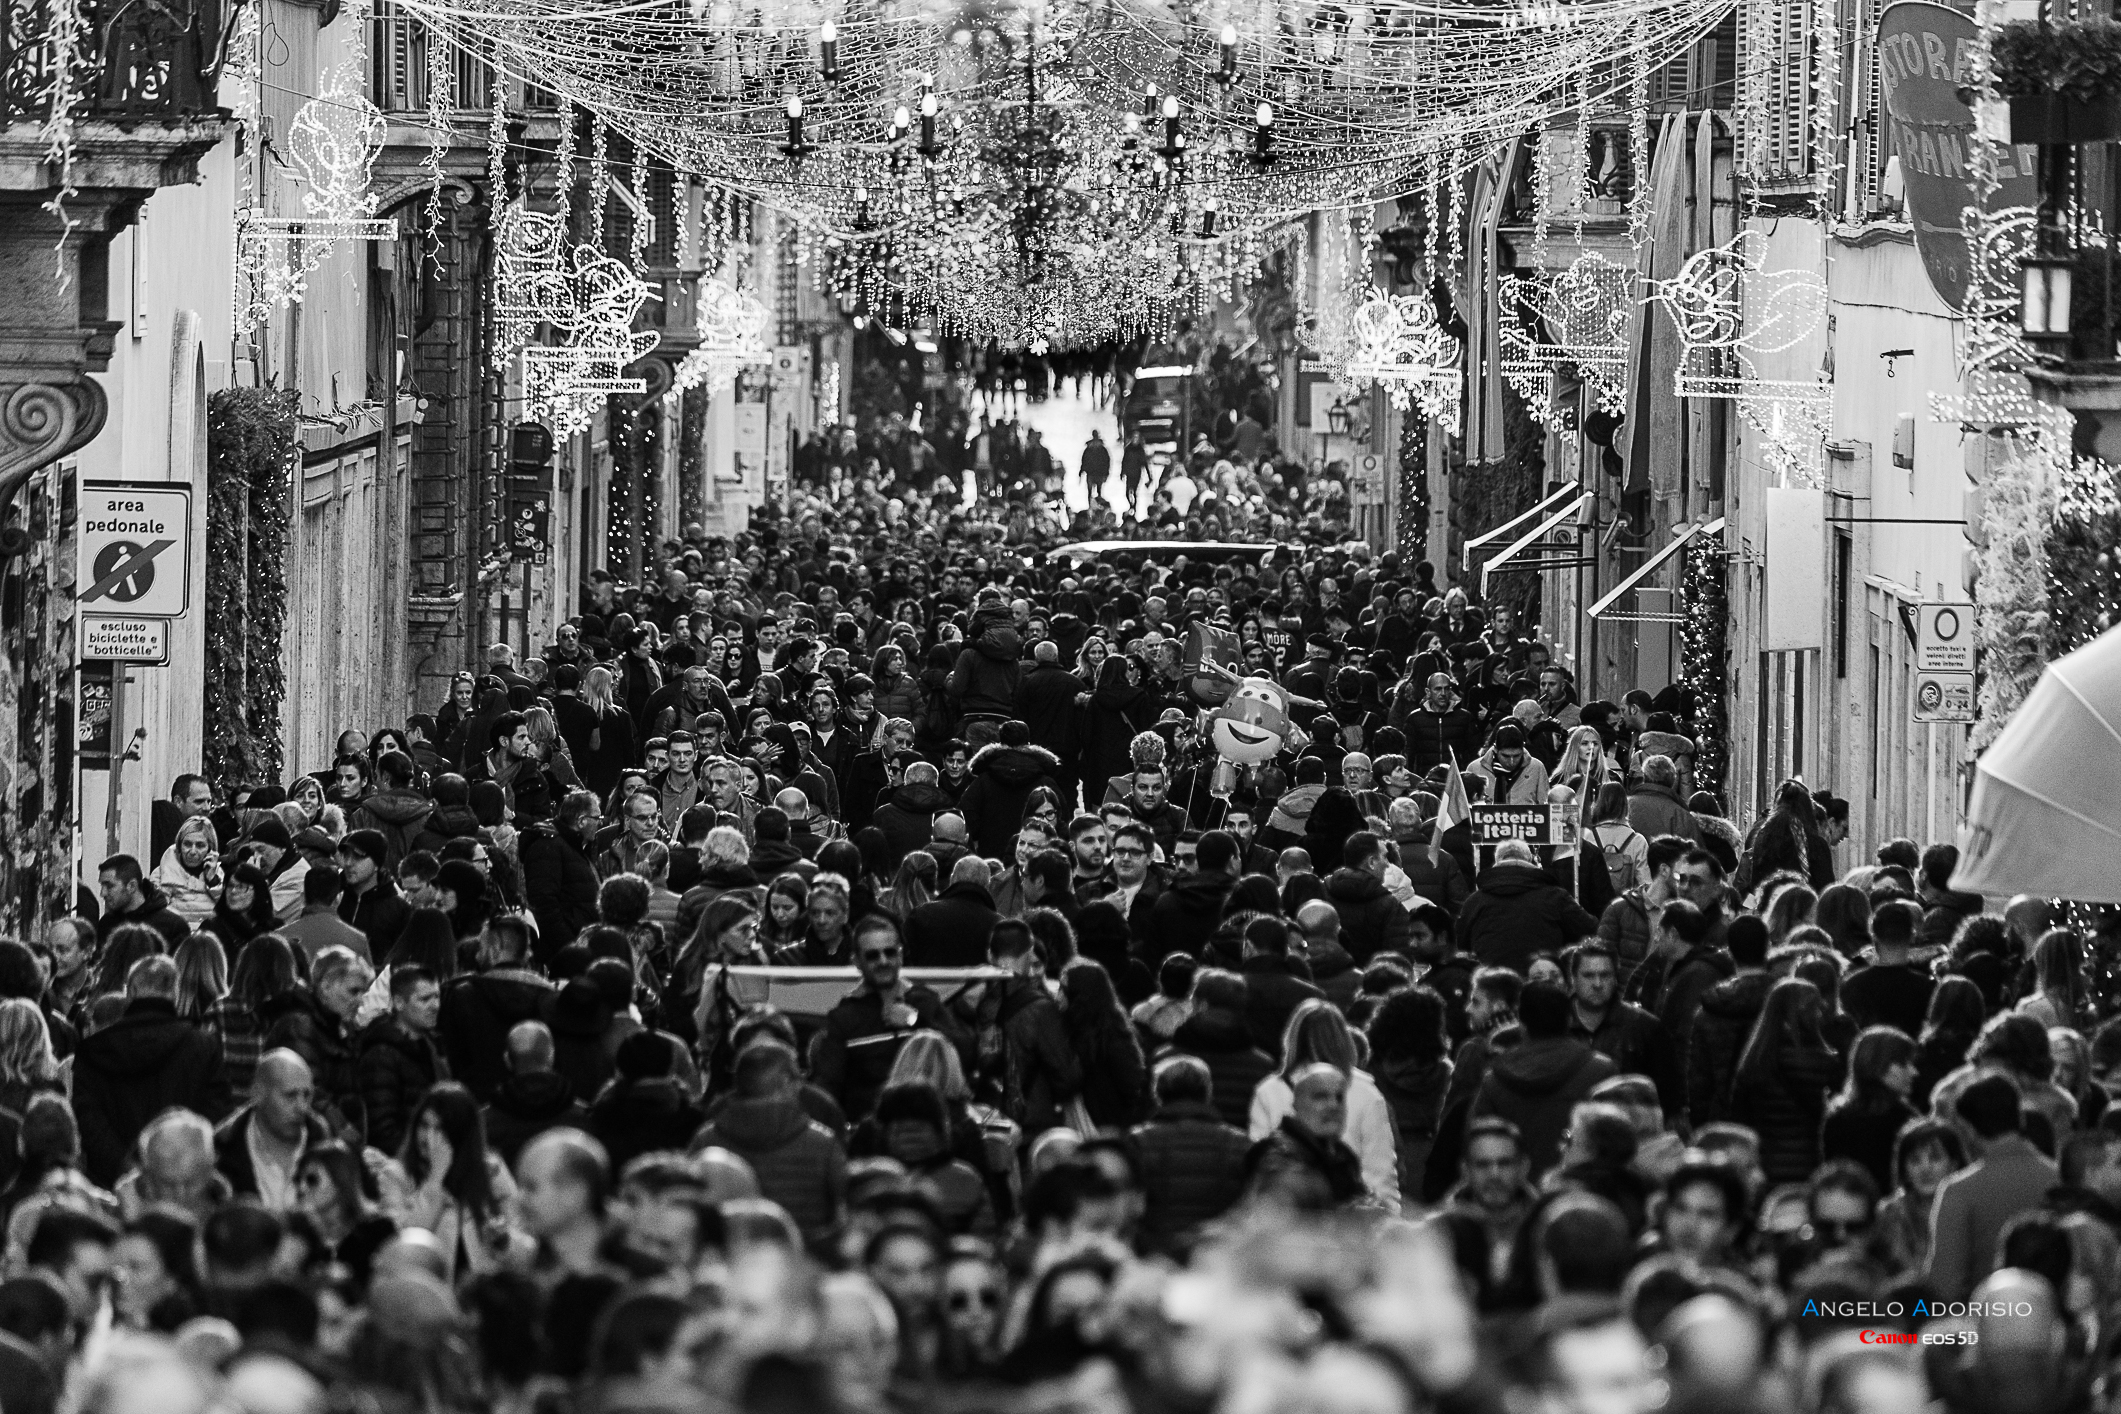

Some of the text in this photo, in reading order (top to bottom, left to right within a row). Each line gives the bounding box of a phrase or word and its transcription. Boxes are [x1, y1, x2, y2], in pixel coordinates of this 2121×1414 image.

[107, 500, 144, 512] area
[85, 518, 165, 534] pedonale
[100, 620, 146, 632] escluso
[89, 632, 158, 644] biciclette e
[1474, 809, 1545, 824] Lotteria
[1484, 823, 1538, 841] Italia
